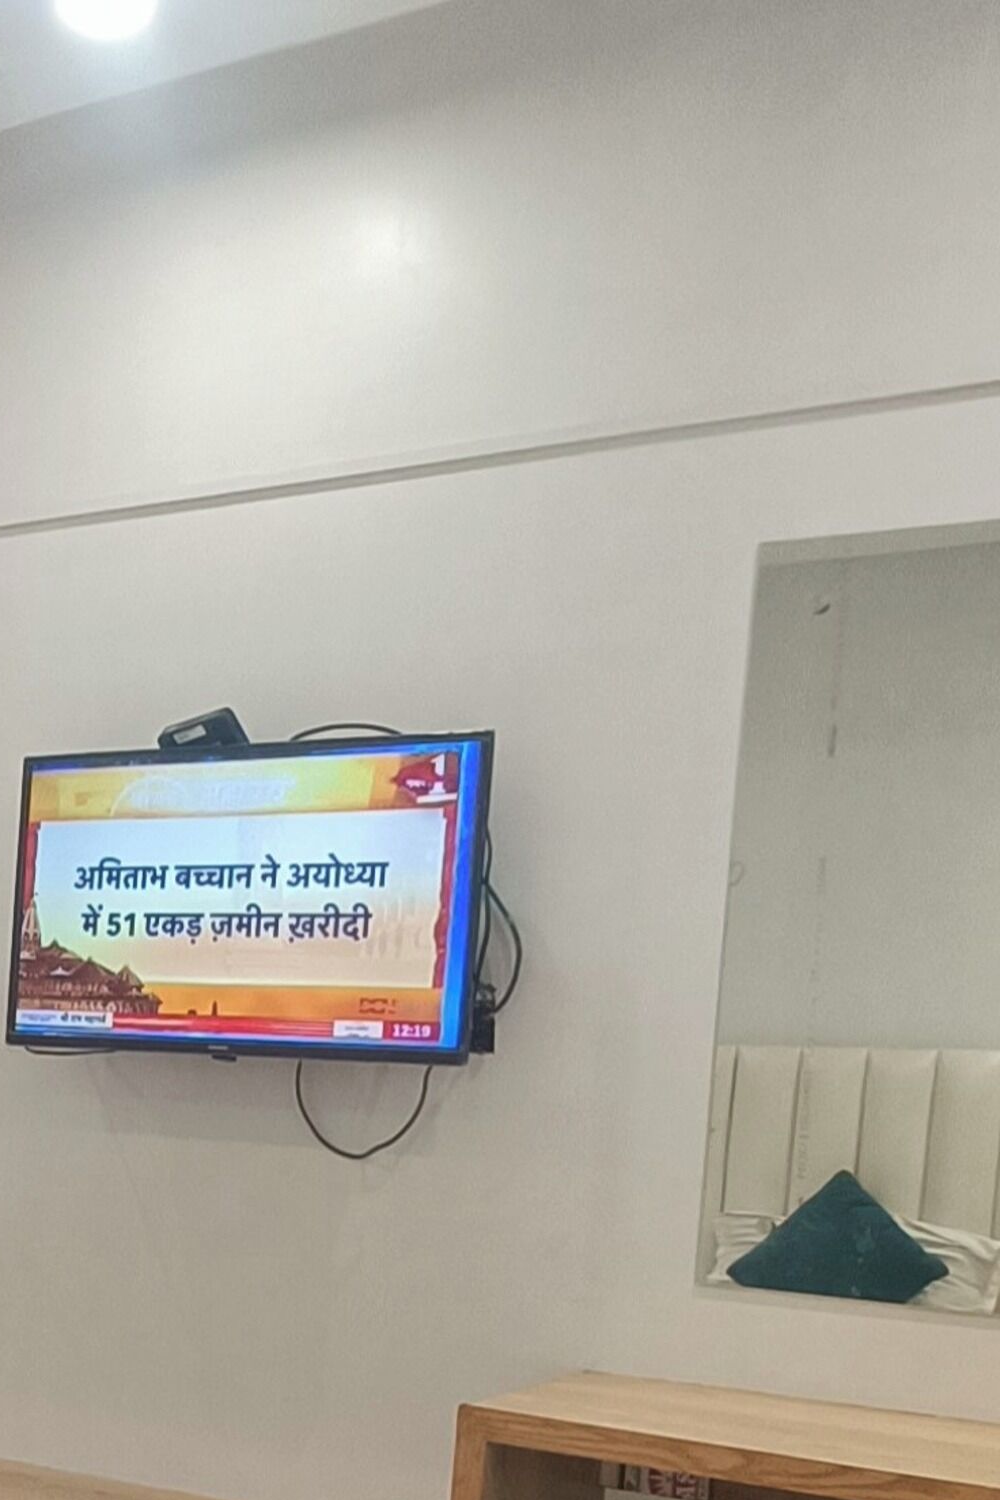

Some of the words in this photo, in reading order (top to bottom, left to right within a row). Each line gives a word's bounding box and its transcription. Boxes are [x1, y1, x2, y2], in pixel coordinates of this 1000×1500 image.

[74, 857, 169, 890] अमिताभ
[174, 864, 255, 889] बच्चान
[261, 853, 281, 888] ने
[287, 853, 389, 888] अयोध्या
[81, 904, 103, 937] में
[106, 913, 136, 937] 51
[144, 912, 204, 945] एकड़
[209, 903, 283, 942] ज़मीन
[288, 902, 373, 943] ख़रीदी
[392, 1023, 431, 1038] 12:19
